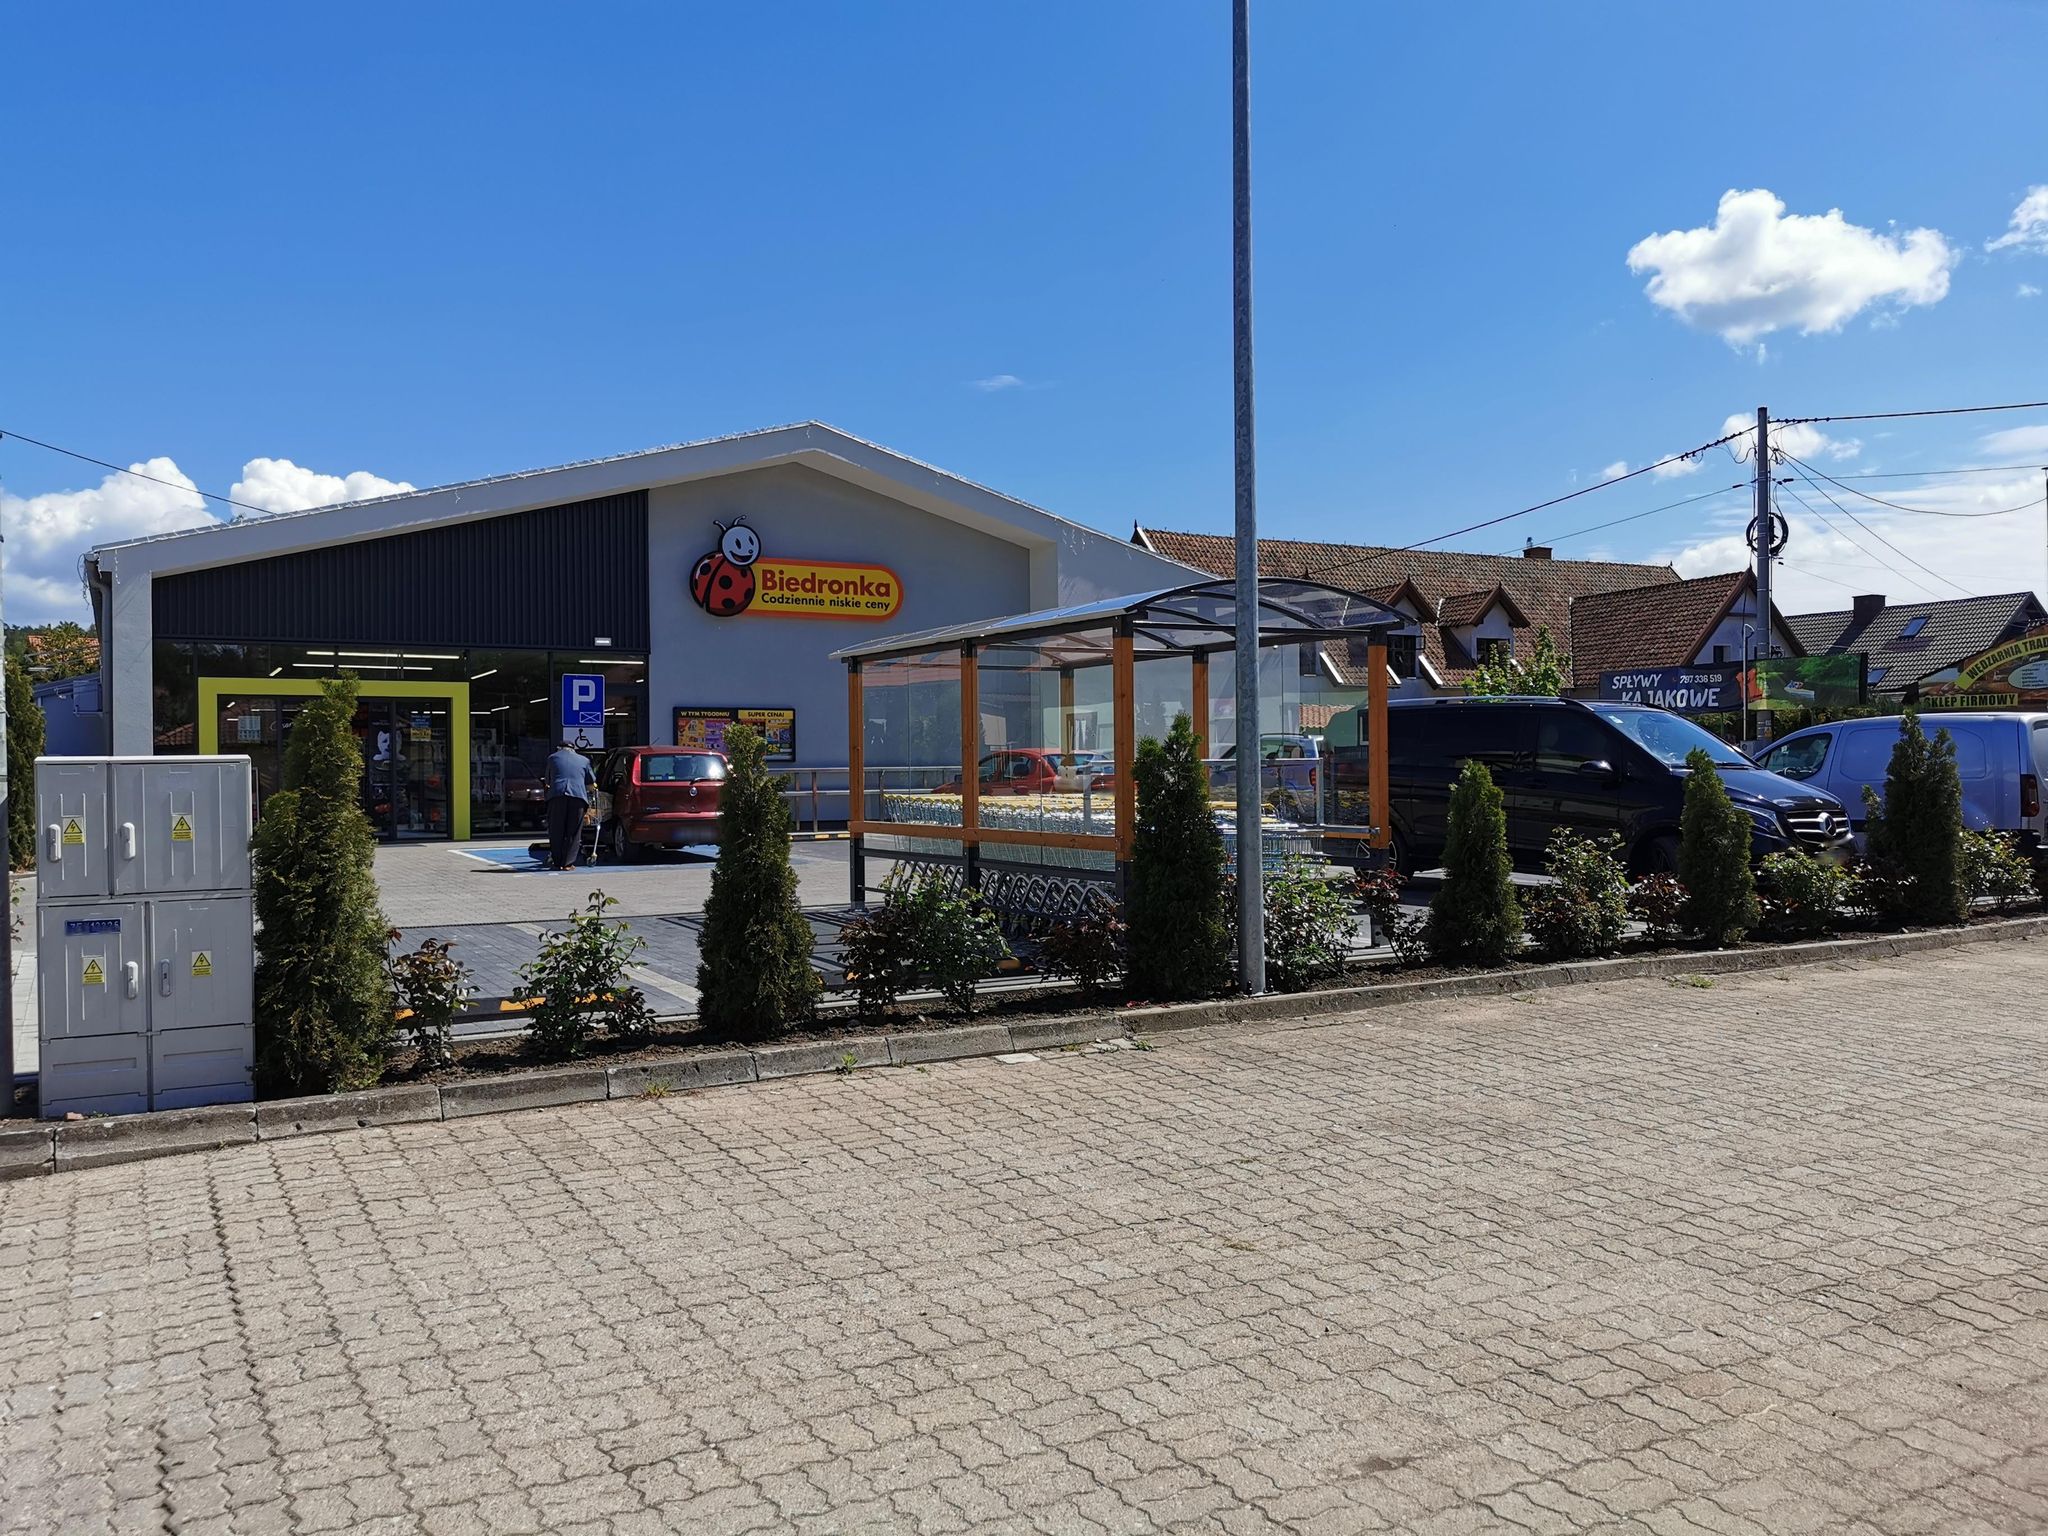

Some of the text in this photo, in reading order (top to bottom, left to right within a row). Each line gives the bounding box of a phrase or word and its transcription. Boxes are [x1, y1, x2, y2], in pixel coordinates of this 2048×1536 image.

[761, 569, 891, 598] Biedronka
[761, 592, 890, 611] Codziennie niskie ceny
[1612, 674, 1661, 689] SPŁYWY
[1694, 674, 1708, 683] 336
[1709, 673, 1722, 682] 519
[573, 679, 595, 711] P
[1924, 694, 2016, 708] SKLEP FIRMOWY
